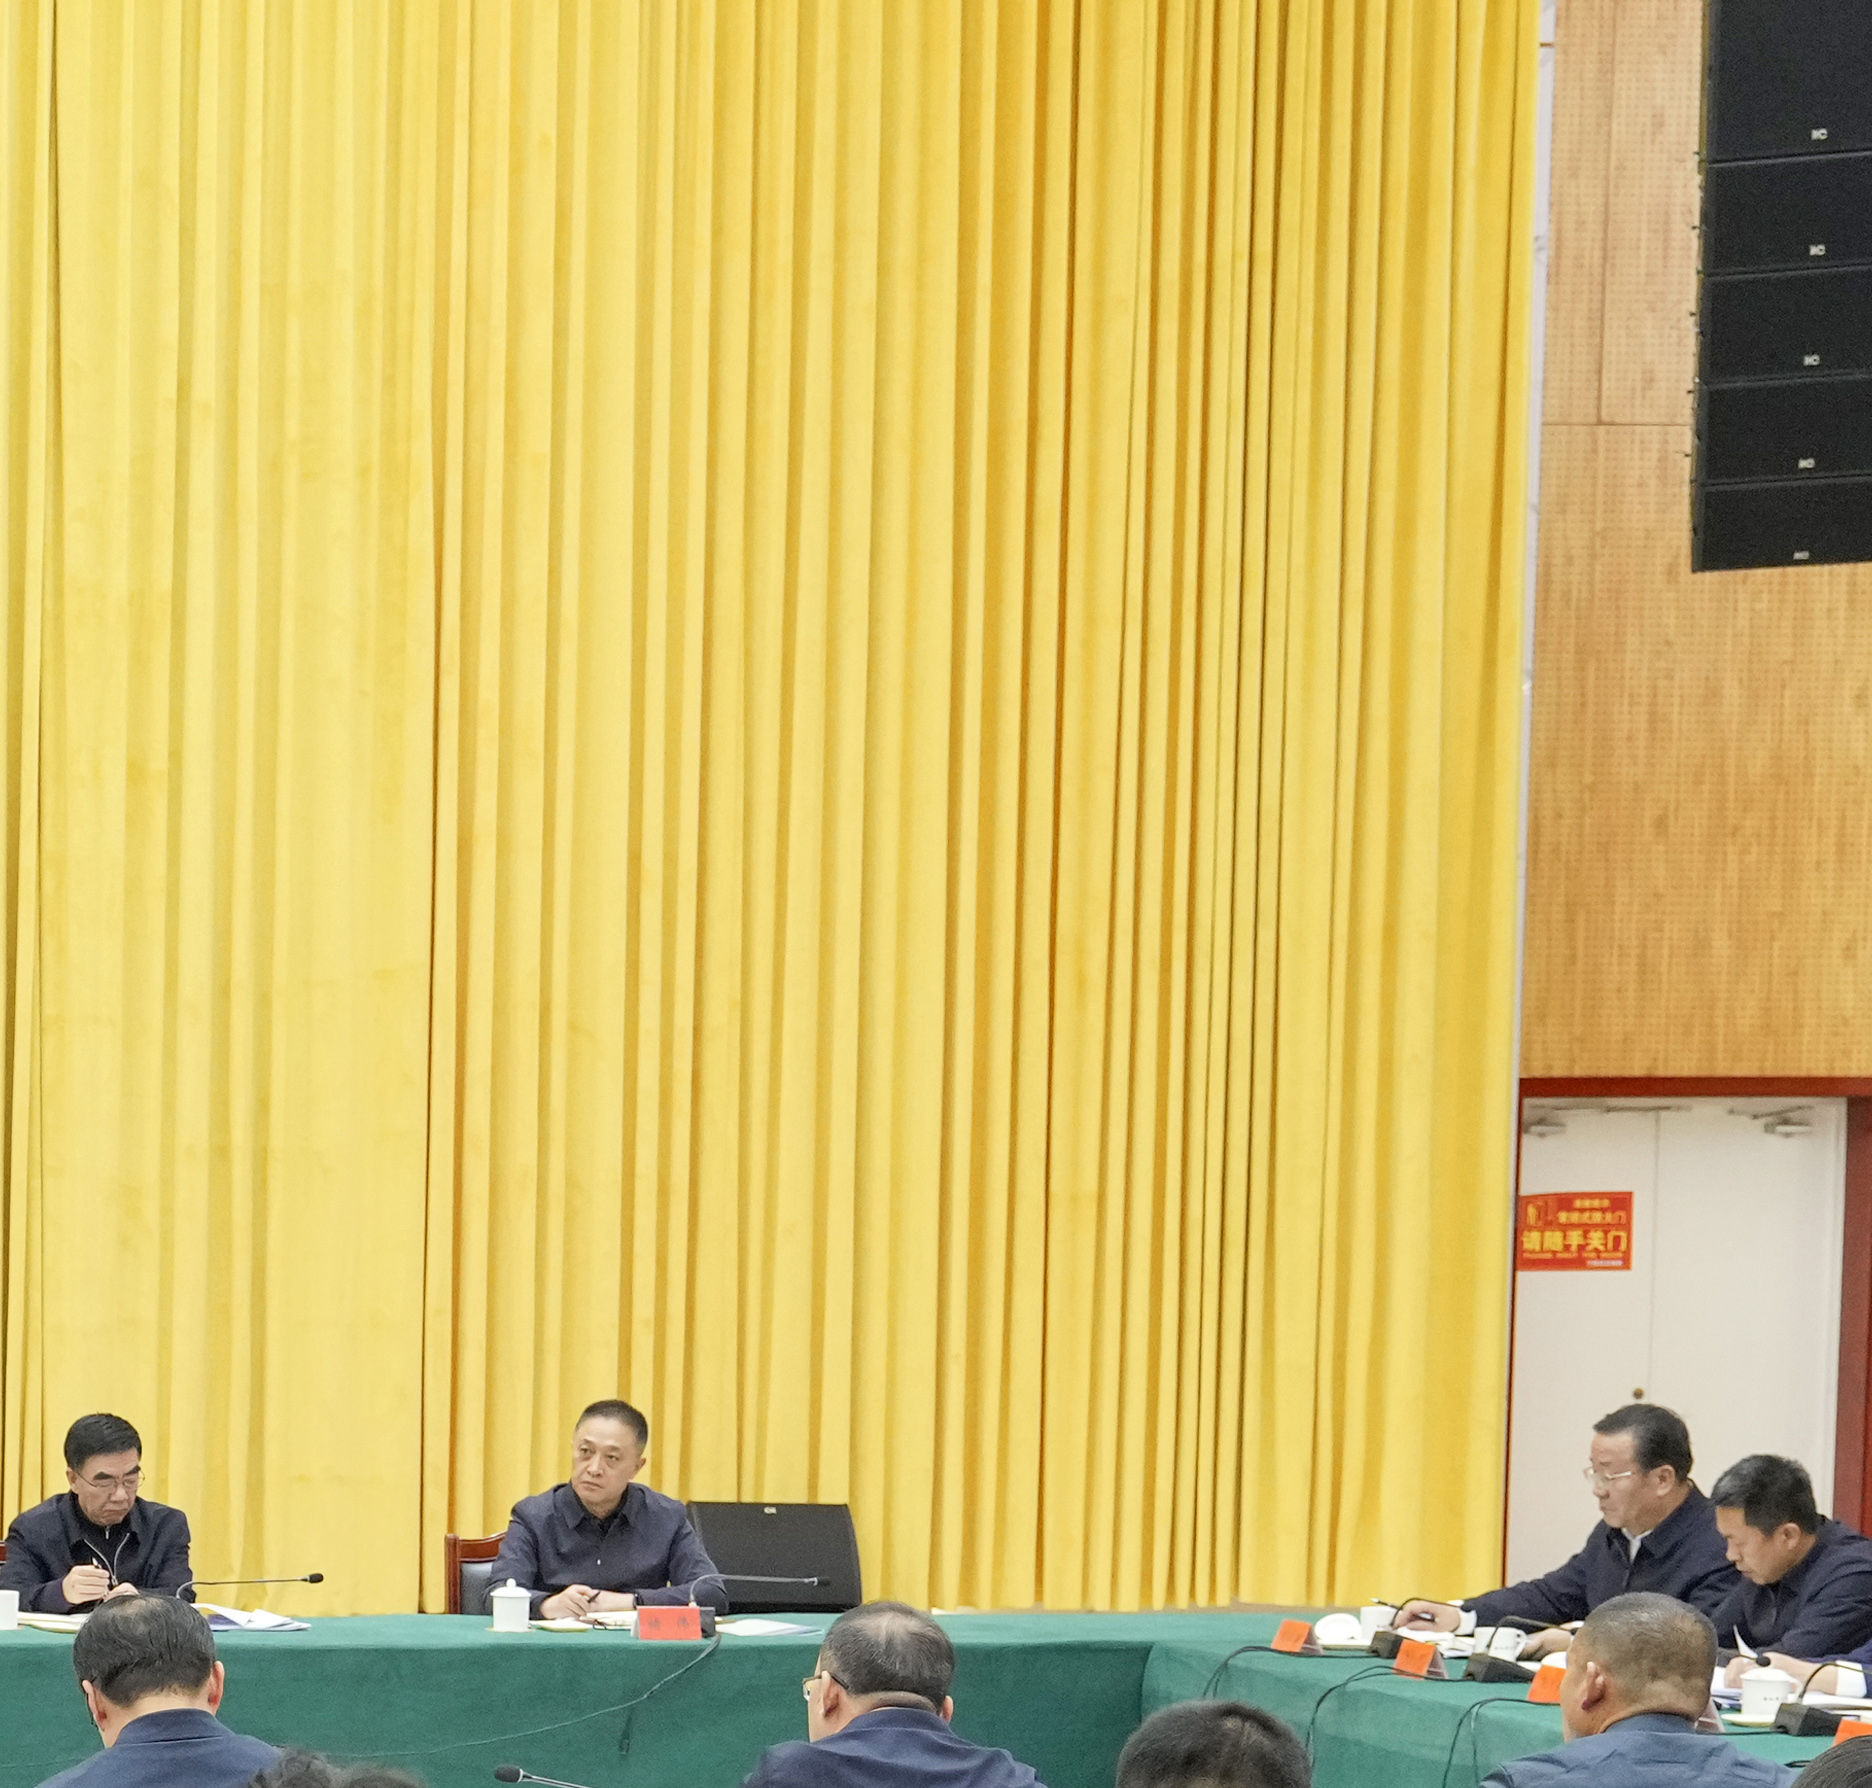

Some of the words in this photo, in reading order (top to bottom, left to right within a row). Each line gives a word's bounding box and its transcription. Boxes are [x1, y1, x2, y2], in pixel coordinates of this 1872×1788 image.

[1521, 1230, 1627, 1252] 请随手关门
